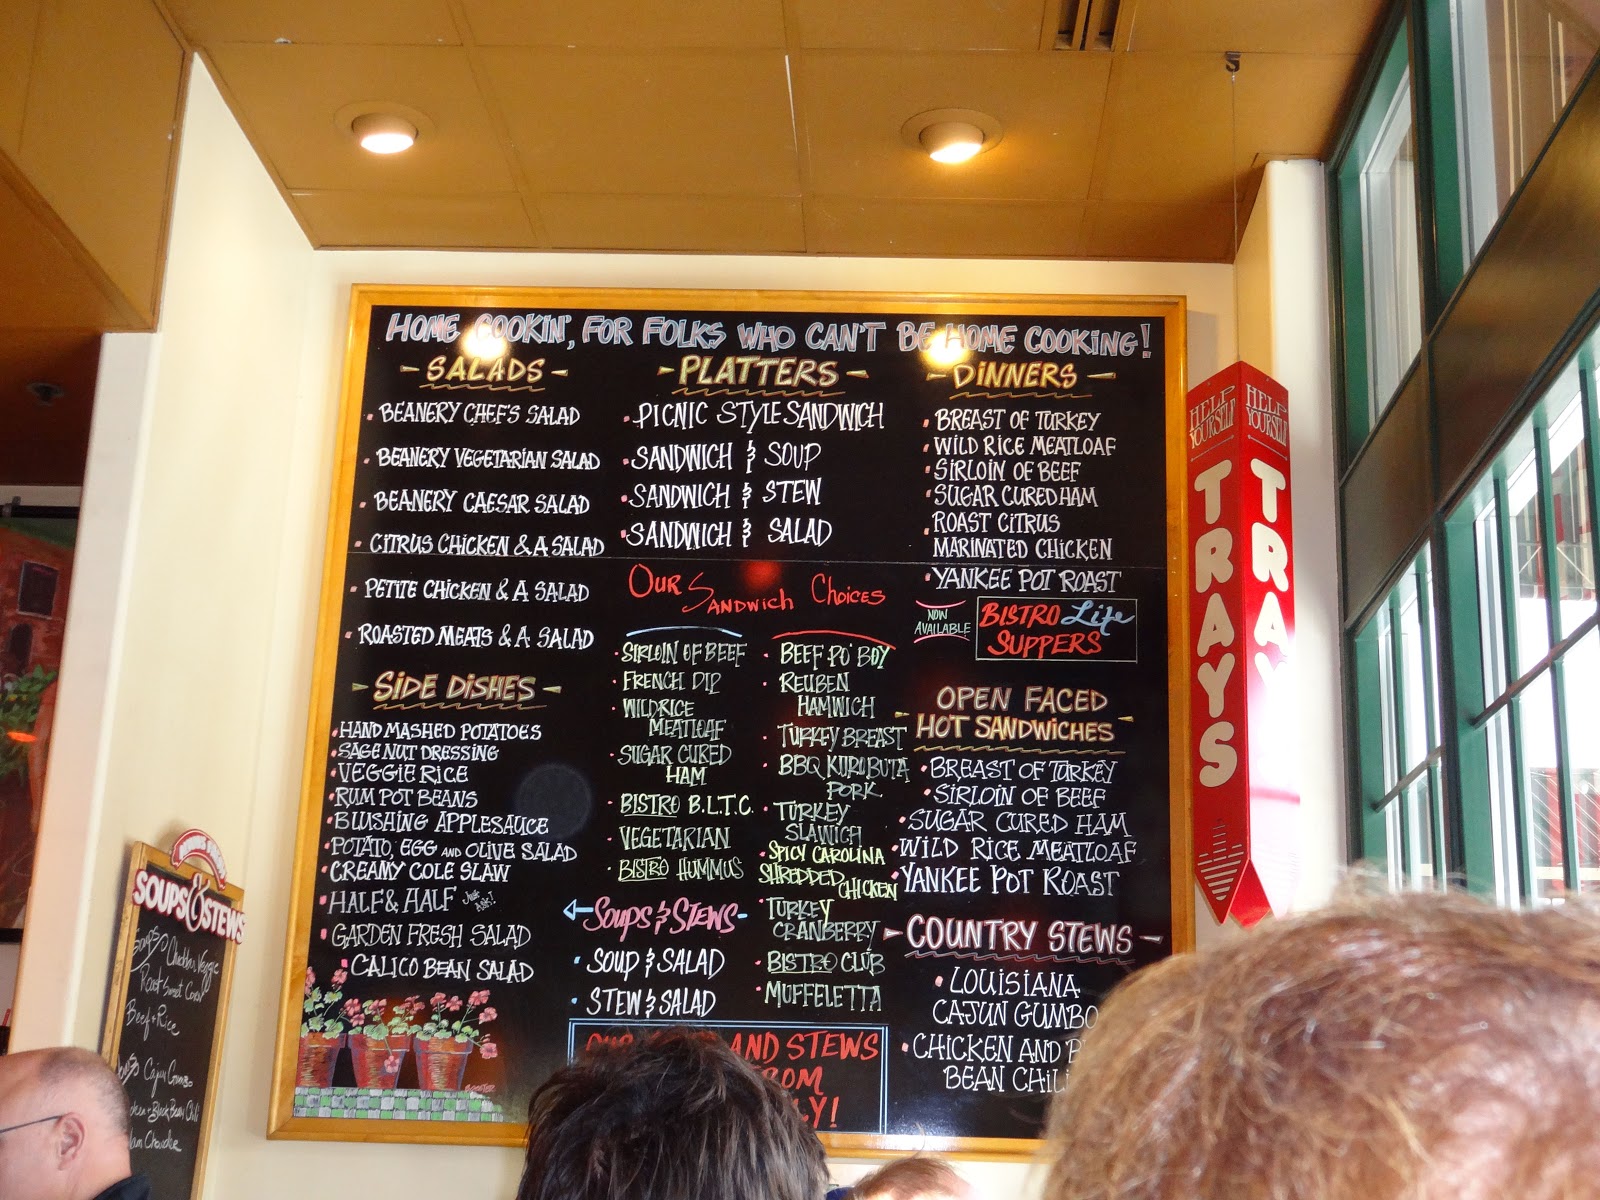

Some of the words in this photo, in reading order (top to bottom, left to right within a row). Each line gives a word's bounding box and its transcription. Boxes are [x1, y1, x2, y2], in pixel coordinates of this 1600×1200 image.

[385, 312, 461, 342] HOME
[582, 316, 633, 345] FOR
[642, 317, 726, 349] FOLKS
[737, 322, 795, 351] WHO
[805, 322, 886, 352] CAN'T
[897, 322, 935, 351] BE
[944, 323, 1018, 354] HOME
[427, 355, 545, 383] SALADS
[678, 354, 840, 387] PLATTERS
[1190, 385, 1235, 432] HELP
[1246, 383, 1287, 416] HELP
[379, 401, 462, 424] BEANERY
[464, 403, 521, 425] CHEF'S
[525, 405, 580, 425] SALAD
[633, 401, 708, 429] PICNIC
[717, 401, 781, 433] STYLE
[784, 401, 884, 430] SANDWICH
[934, 408, 1006, 431] BREAST
[1009, 410, 1029, 430] OF
[1035, 411, 1101, 432] TURKEY
[1189, 398, 1236, 449] YOURSELF
[1246, 406, 1287, 447] YOURSELF
[376, 447, 450, 468] BEANERY
[551, 450, 600, 470] SALAD
[631, 442, 732, 473] SANDWICH
[764, 442, 821, 470] SOUP
[1029, 437, 1116, 457] MEATLOAF
[1013, 461, 1034, 481] OF
[1038, 461, 1081, 482] BEEF
[374, 489, 458, 512] BEANERY
[463, 492, 530, 513] CAESAR
[534, 494, 590, 514] SALAD
[629, 482, 731, 508] SANDWICH
[762, 477, 821, 504] STEW
[934, 484, 999, 507] SUGAR
[1002, 486, 1057, 507] CURED
[1059, 487, 1098, 507] HAM
[626, 518, 731, 549] SANDWICH
[768, 517, 832, 546] SALAD
[932, 511, 991, 534] ROAST
[932, 567, 1012, 590] YANKEE
[1018, 569, 1056, 591] POT
[1058, 569, 1121, 593] ROAST
[927, 609, 948, 621] NOW
[979, 602, 1060, 628] BISTRO
[1194, 459, 1237, 787] TRAYS
[358, 623, 434, 646] ROASTED
[435, 626, 494, 647] MEATS
[537, 627, 594, 649] SALAD
[914, 622, 971, 636] AVAILABLE
[620, 641, 678, 664] SIRLOIN
[684, 642, 703, 664] OF
[705, 642, 748, 667] BEEF
[780, 642, 823, 671] BEEF
[857, 645, 890, 669] BOY
[987, 631, 1101, 658] SUPPERS
[623, 671, 685, 692] FRENCH
[693, 672, 721, 694] DIP
[779, 671, 850, 693] REUBEN
[797, 695, 876, 719] HAMWICH
[937, 686, 1012, 712] OPEN
[1025, 686, 1108, 714] FACED
[339, 721, 382, 739] HAND
[384, 723, 455, 740] MASHED
[460, 723, 542, 740] POTATOES
[777, 723, 839, 751] TURKEY
[843, 726, 907, 750] BREAST
[916, 713, 970, 739] HOT
[338, 742, 381, 759] SAGE
[382, 744, 417, 761] NUT
[617, 744, 673, 766] SUGAR
[678, 744, 731, 766] CURED
[666, 766, 707, 787] HAM
[778, 754, 826, 780] BBQ
[930, 757, 1015, 781] BREAST
[1019, 761, 1047, 780] OF
[1049, 760, 1118, 783] TURKEY
[334, 787, 375, 808] RUM
[379, 788, 413, 805] POT
[417, 790, 478, 808] BEANS
[827, 781, 883, 800] PORK
[1021, 787, 1048, 807] OF
[1055, 787, 1106, 808] BEEF
[620, 793, 680, 816] BISTRO
[773, 801, 850, 825] TURKEY
[434, 811, 548, 835] APPLESAUCE
[907, 809, 987, 832] SUGAR
[996, 812, 1068, 834] CURED
[1074, 812, 1132, 837] HAM
[401, 839, 438, 857] EGG
[442, 847, 461, 857] AND
[619, 826, 731, 850] VEGETARIAN
[769, 840, 805, 863] SPICY
[812, 846, 885, 865] CAROLINA
[1026, 839, 1137, 864] MEATLOAF
[330, 860, 406, 882] CREAMY
[409, 861, 453, 881] COLE
[460, 861, 511, 883] SLAW
[618, 856, 669, 882] BISTRO
[676, 857, 744, 881] HUMMUS
[759, 863, 844, 886] SHREDDED
[900, 862, 981, 893] YANKEE
[990, 865, 1033, 894] POT
[1042, 866, 1120, 896] ROAST
[402, 886, 457, 913] HALF
[838, 879, 898, 900] CHICKEN
[132, 869, 188, 920] SOUPS
[203, 897, 247, 945] STEWS
[766, 897, 834, 925] TURKEY
[332, 924, 403, 949] GARDEN
[407, 924, 464, 949] FRESH
[470, 924, 531, 949] SALAD
[773, 920, 880, 950] CRANBERRY
[906, 914, 1038, 950] COUNTRY
[1048, 919, 1133, 954] STEWS
[351, 954, 418, 977] CALICO
[423, 959, 471, 981] BEAN
[477, 959, 534, 983] SALAD
[587, 948, 639, 980] SOUP
[657, 949, 724, 980] SALAD
[767, 951, 837, 974] BISTRO
[840, 952, 885, 976] CLUB
[587, 987, 640, 1016] STEW
[659, 988, 716, 1017] SALAD
[765, 981, 882, 1011] MUFFELETTA
[932, 999, 1008, 1027] CAJUN
[1014, 1001, 1099, 1029] GUMBO
[730, 1031, 779, 1064] AND
[786, 1030, 879, 1060] STEWS
[1018, 1039, 1060, 1064] AND
[943, 1065, 1005, 1092] BEAN
